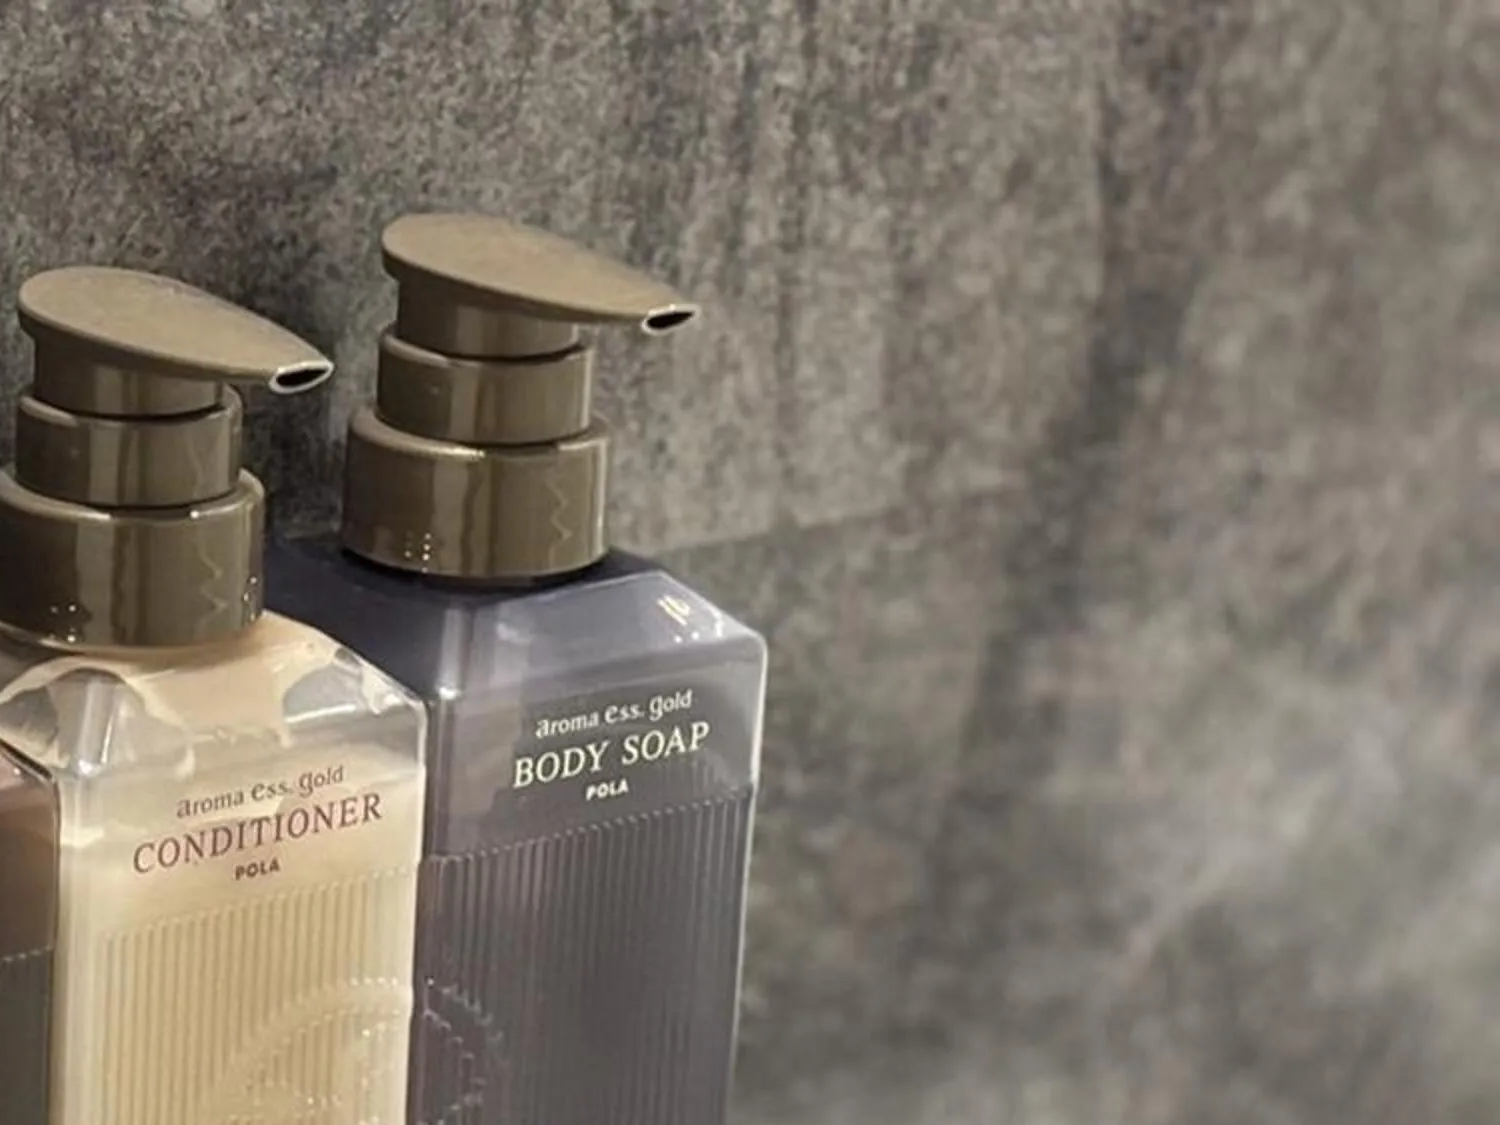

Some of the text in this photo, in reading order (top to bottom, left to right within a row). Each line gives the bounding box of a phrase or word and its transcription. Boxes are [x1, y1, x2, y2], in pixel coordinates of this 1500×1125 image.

[535, 688, 693, 739] aroma ess. gold
[513, 721, 710, 788] BODY SOAP
[176, 766, 344, 819] aroma ess. gold
[585, 778, 629, 800] POLA
[132, 792, 383, 874] CONDITIONER
[235, 857, 281, 881] POLA
